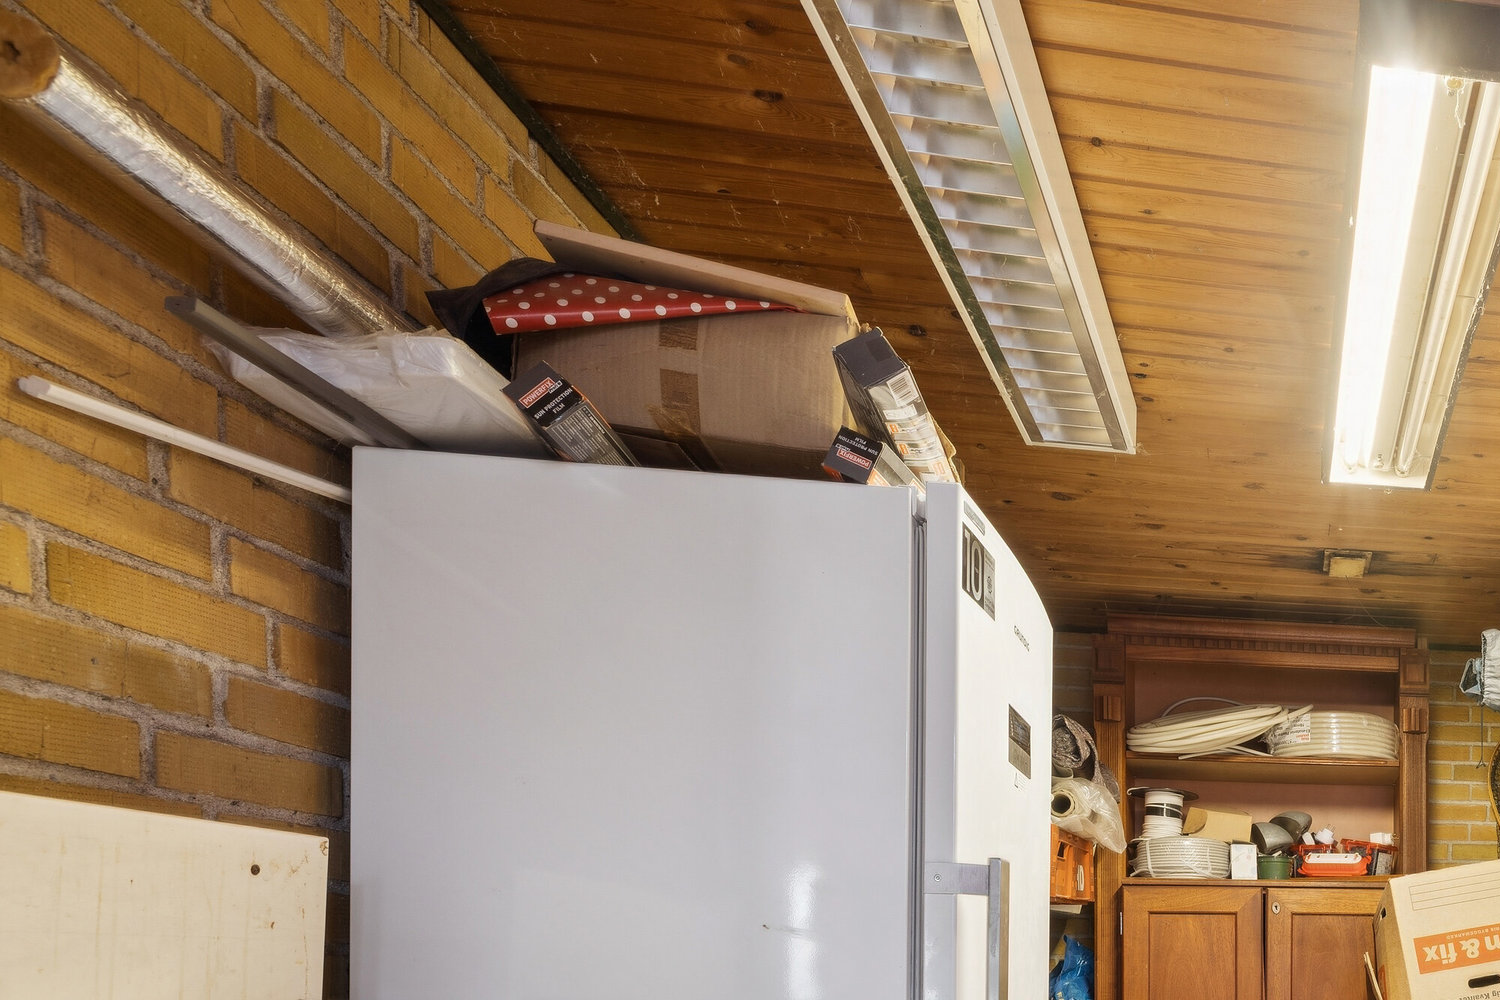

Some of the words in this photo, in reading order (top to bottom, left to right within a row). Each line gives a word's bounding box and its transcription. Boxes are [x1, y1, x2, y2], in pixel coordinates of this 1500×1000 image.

[522, 379, 555, 407] POWERFIX
[534, 409, 546, 420] SUN
[543, 387, 573, 413] PROTECTION
[552, 403, 566, 415] FILM
[838, 449, 871, 469] POWERFIX
[964, 528, 982, 601] 10
[1423, 942, 1458, 964] fix
[1460, 938, 1480, 959] &
